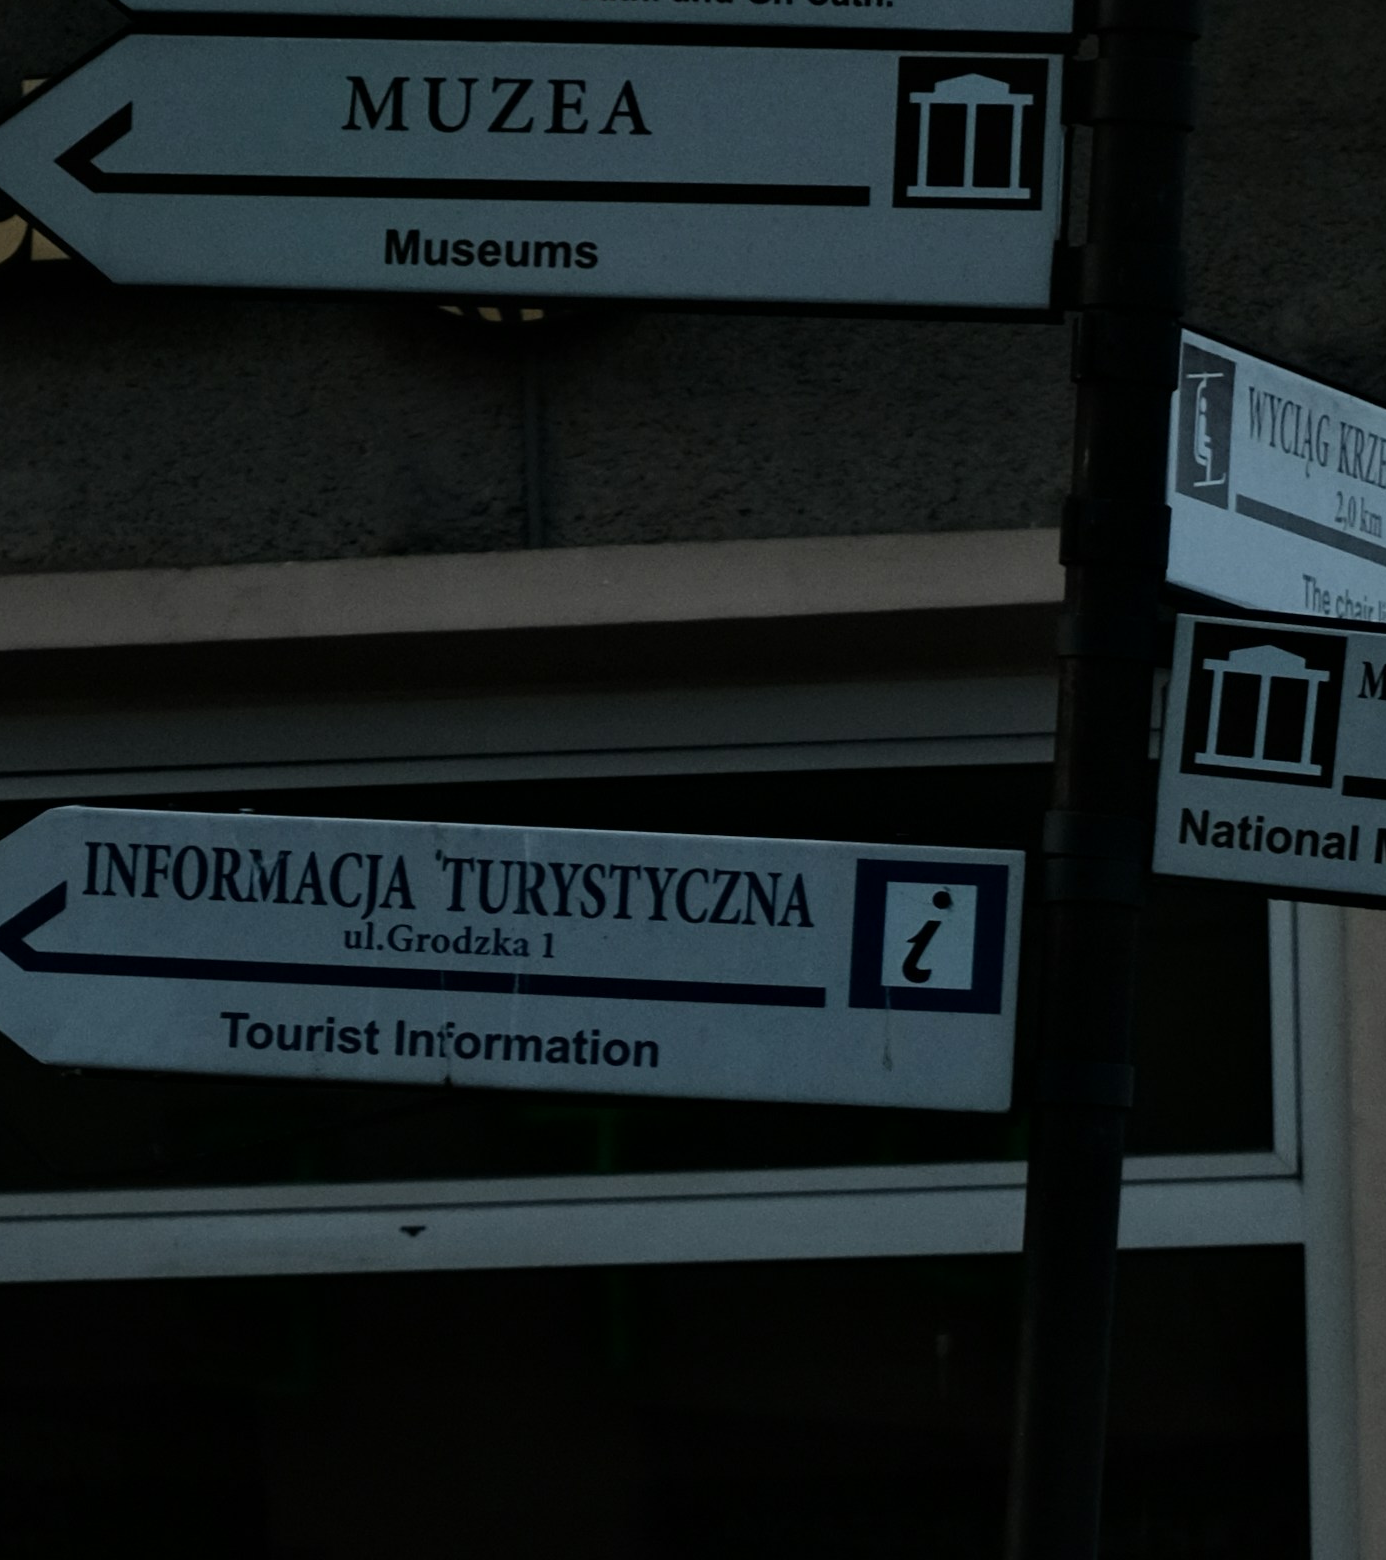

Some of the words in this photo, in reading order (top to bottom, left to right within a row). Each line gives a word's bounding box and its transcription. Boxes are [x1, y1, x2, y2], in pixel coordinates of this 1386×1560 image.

[340, 75, 653, 136] MUZEA
[384, 228, 599, 270] Museums
[1248, 385, 1331, 478] WYCIĄG
[1334, 490, 1357, 528] 2,0
[1359, 496, 1382, 539] km
[1302, 572, 1331, 616] The
[1335, 589, 1375, 621] chair
[1178, 807, 1360, 862] National
[82, 841, 416, 920] INFORMACJA
[444, 855, 815, 930] TURYSTYCZNA
[343, 921, 531, 958] ul.Grodzka
[542, 932, 555, 959] 1
[220, 1011, 380, 1056] Tourist
[394, 1019, 659, 1068] Information
